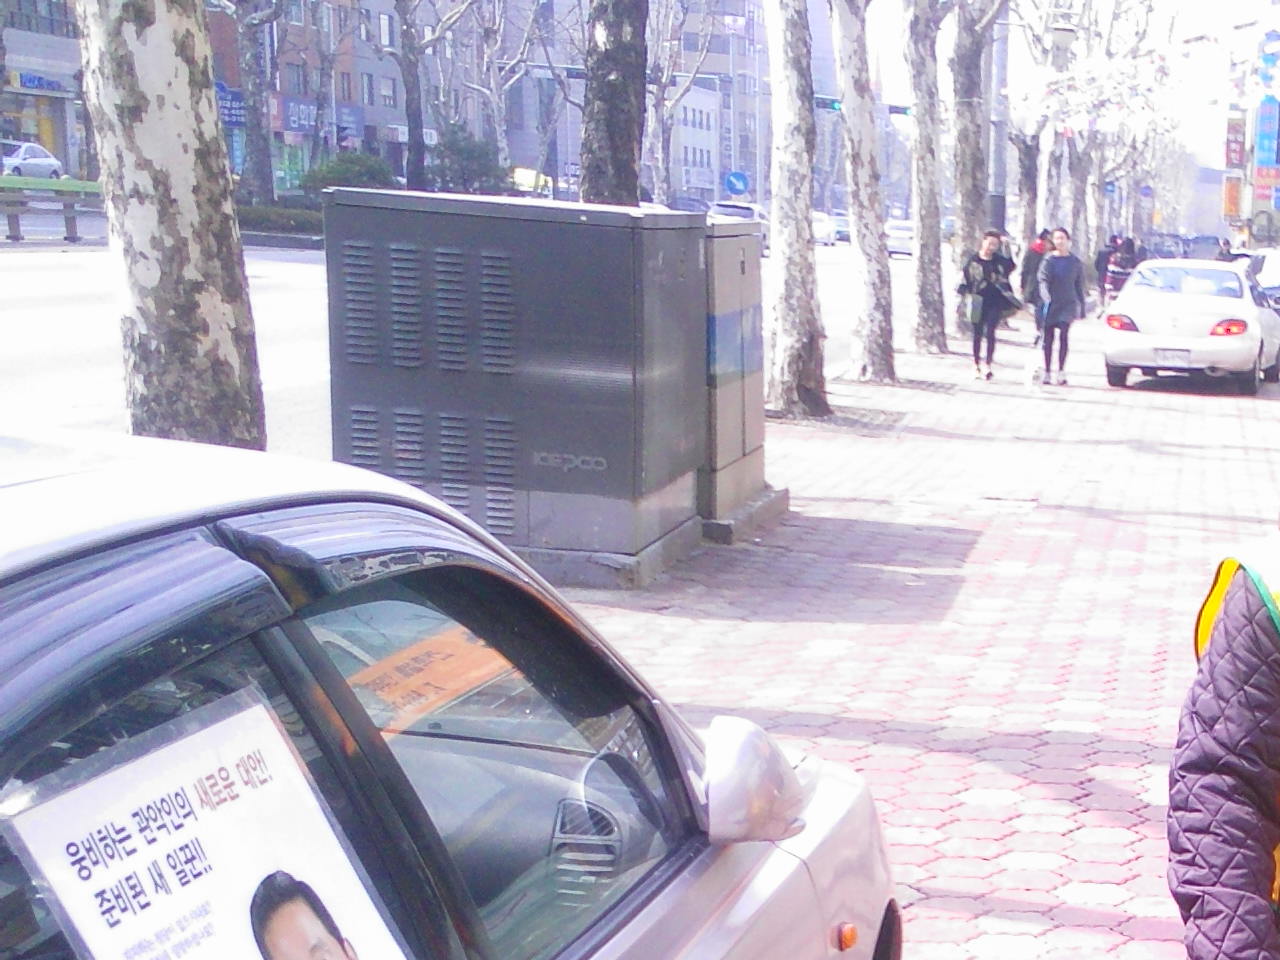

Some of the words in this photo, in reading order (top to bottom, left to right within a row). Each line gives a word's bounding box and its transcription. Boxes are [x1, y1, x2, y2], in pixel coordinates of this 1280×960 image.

[66, 822, 138, 881] 웅비하는
[131, 787, 198, 845] 관악인의
[194, 766, 240, 811] 새로운
[235, 748, 273, 789] 대안!
[94, 871, 151, 928] 준비된
[147, 859, 172, 895] 새
